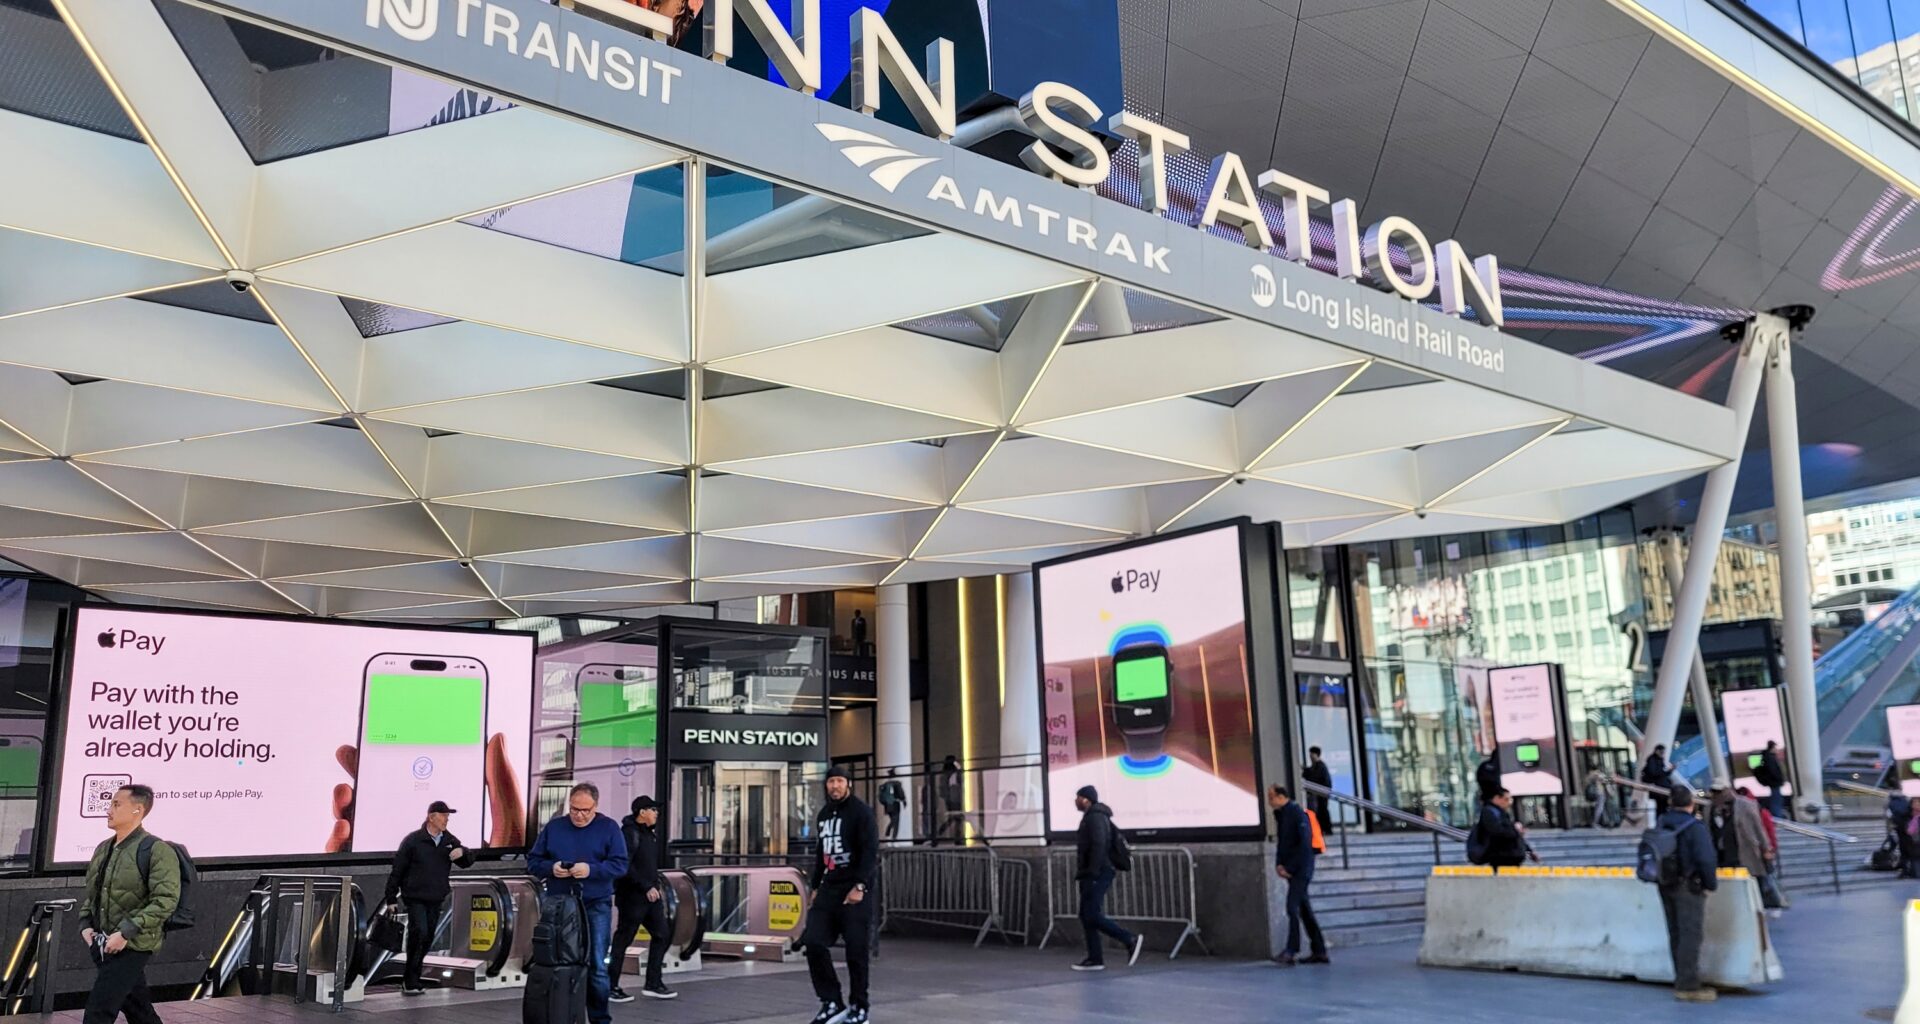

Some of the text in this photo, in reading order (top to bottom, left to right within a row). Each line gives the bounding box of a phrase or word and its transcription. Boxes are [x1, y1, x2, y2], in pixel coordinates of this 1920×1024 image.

[453, 0, 682, 105] TRANSIT
[1019, 81, 1504, 328] STATION
[926, 175, 1171, 274] AMTRAK
[1282, 278, 1340, 329] Long
[1346, 302, 1409, 344] Island
[1415, 321, 1452, 357] Rail
[1458, 335, 1504, 373] Road
[1126, 569, 1161, 592] Pay
[120, 629, 166, 655] Pay
[1625, 621, 1648, 672] 2
[853, 671, 876, 681] ARE
[91, 681, 239, 707] Pay with the
[88, 710, 239, 735] wallet you’re
[84, 737, 276, 763] already holding.
[684, 729, 818, 746] PENN STATION
[153, 789, 264, 801] can to set up Apple Pay.
